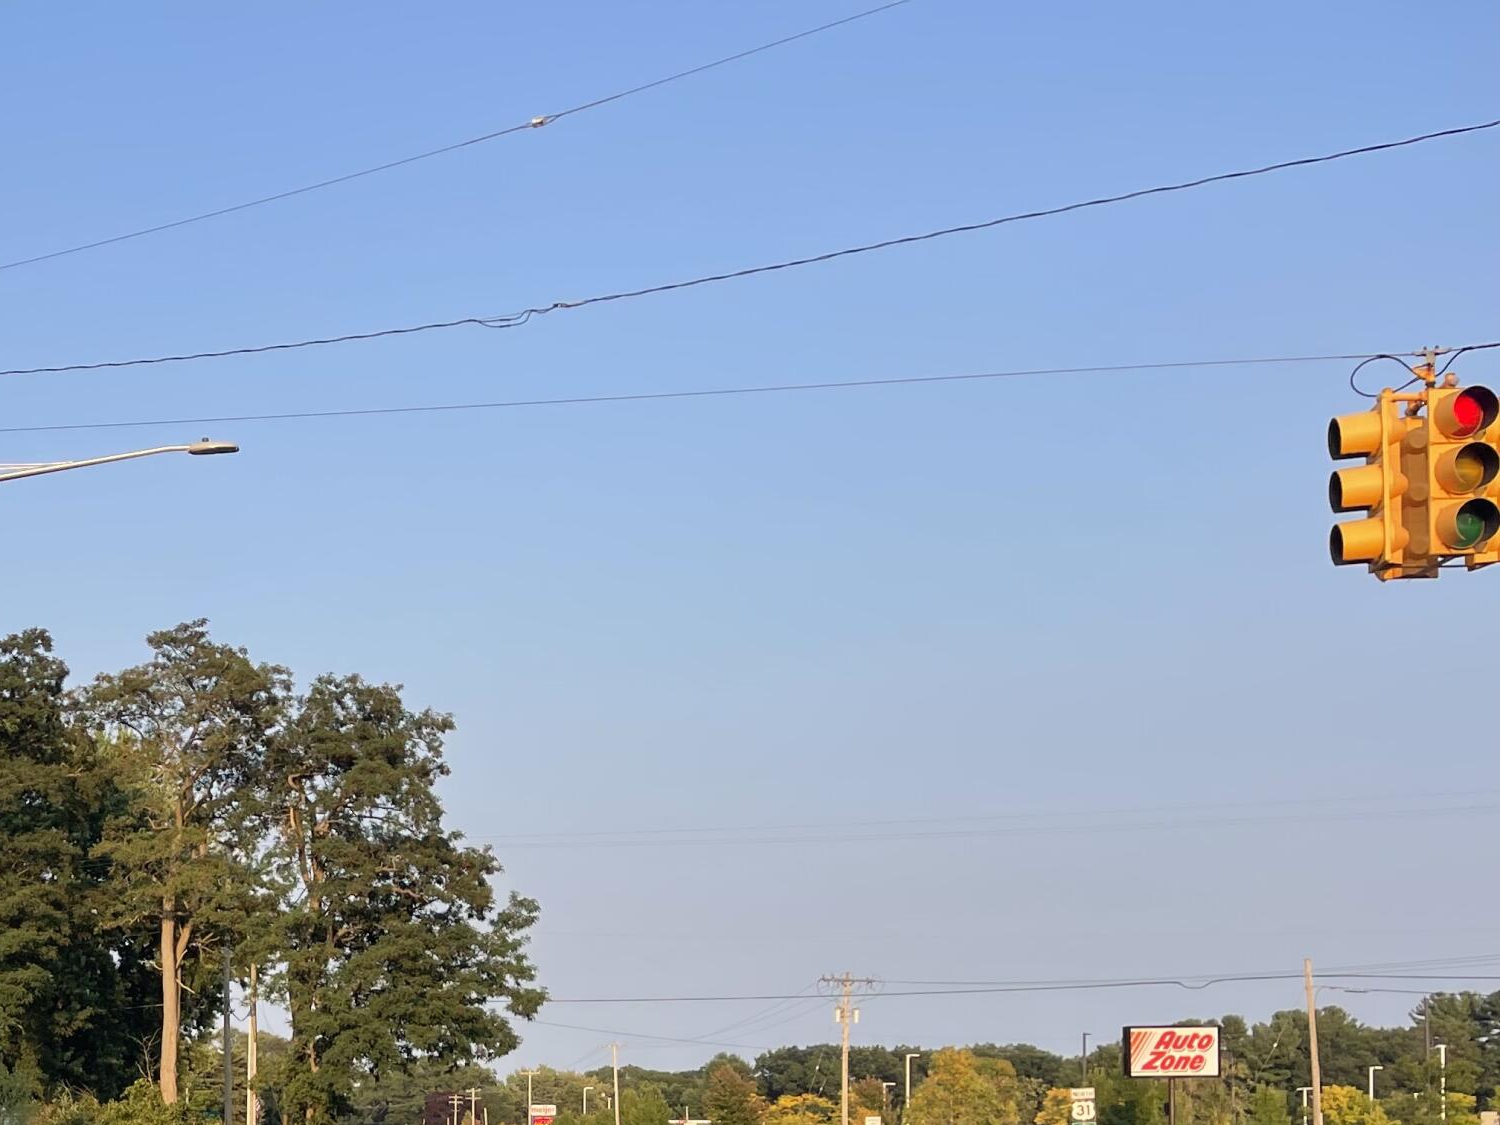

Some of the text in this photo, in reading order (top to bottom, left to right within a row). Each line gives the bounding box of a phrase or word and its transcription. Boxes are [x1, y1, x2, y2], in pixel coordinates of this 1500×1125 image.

[1154, 1030, 1214, 1051] Auto
[1141, 1051, 1205, 1072] Zone
[531, 1106, 555, 1114] meijer
[1076, 1104, 1090, 1116] 31
